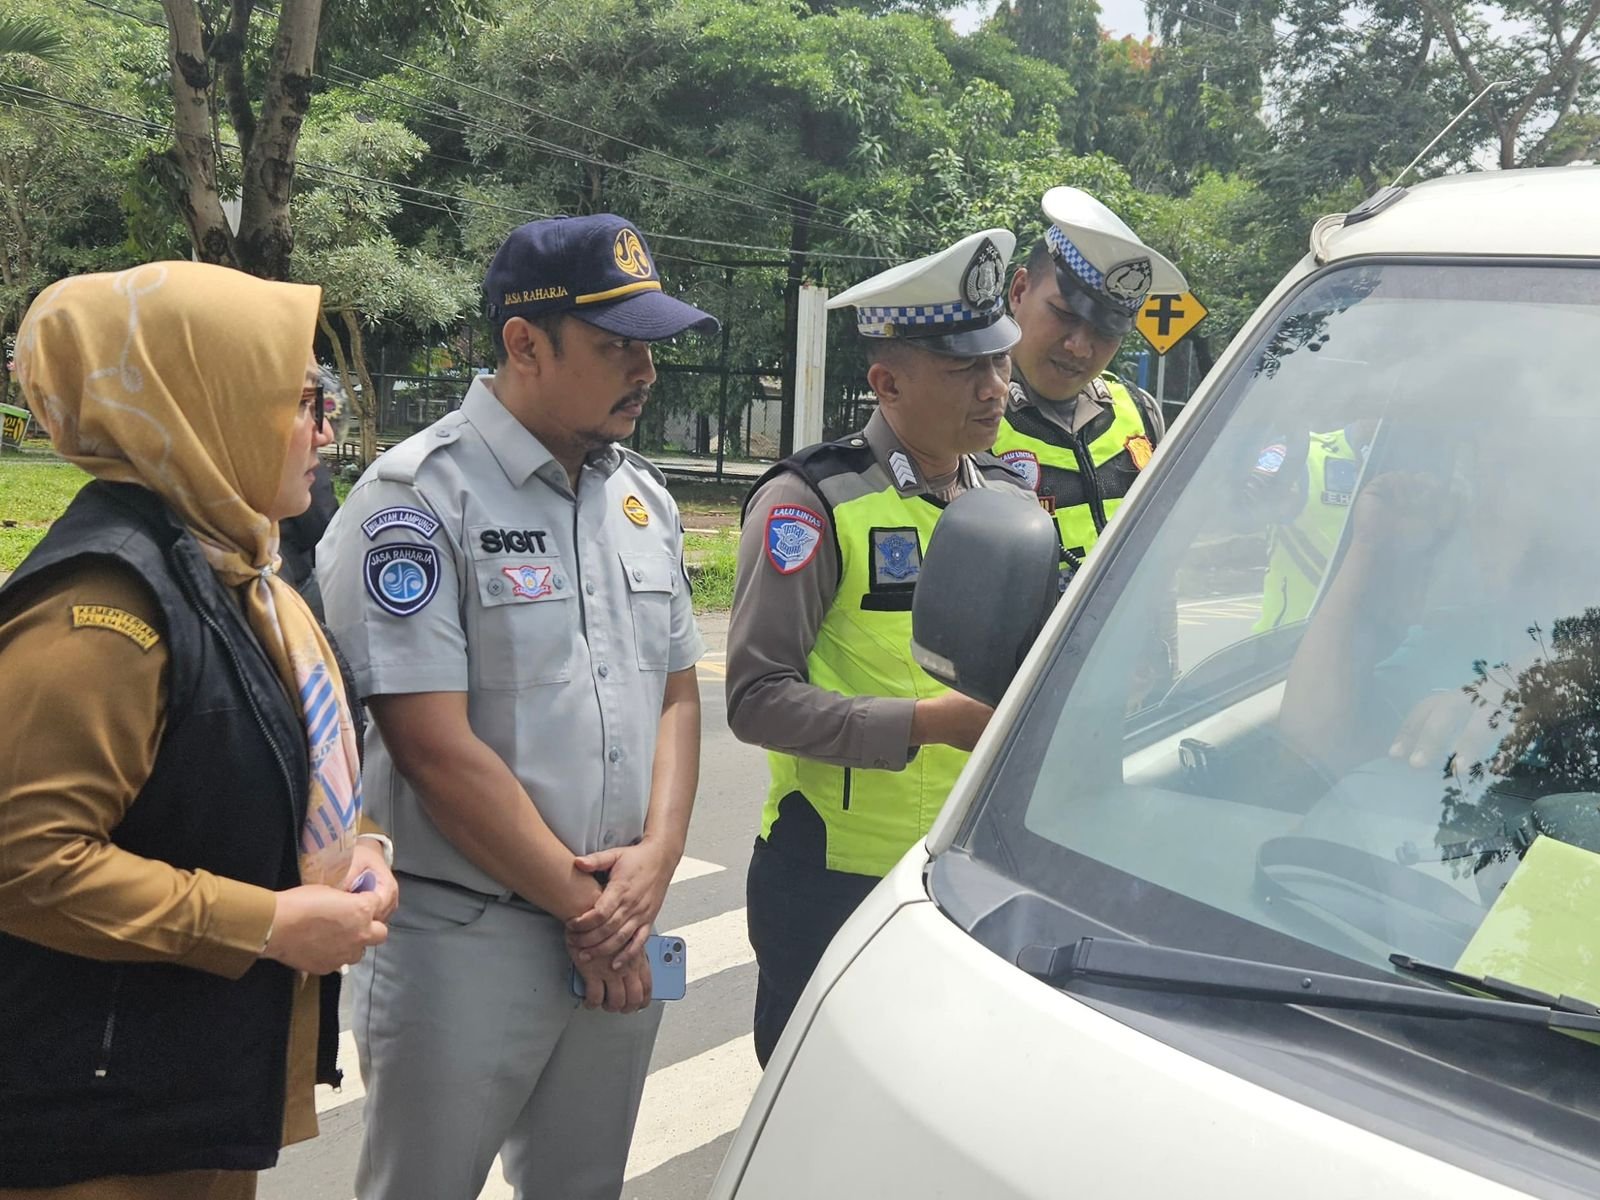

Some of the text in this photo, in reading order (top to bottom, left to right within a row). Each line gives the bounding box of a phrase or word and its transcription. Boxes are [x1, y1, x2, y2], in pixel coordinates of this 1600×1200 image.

[504, 286, 568, 305] JASA RAHARJA
[368, 511, 433, 532] WILAYAH LAMPUNG
[773, 507, 821, 528] LALU LINTAS
[480, 529, 547, 554] SIGIT
[370, 549, 433, 566] JASA RAHARJA
[78, 606, 157, 637] KEMENTERIAN
